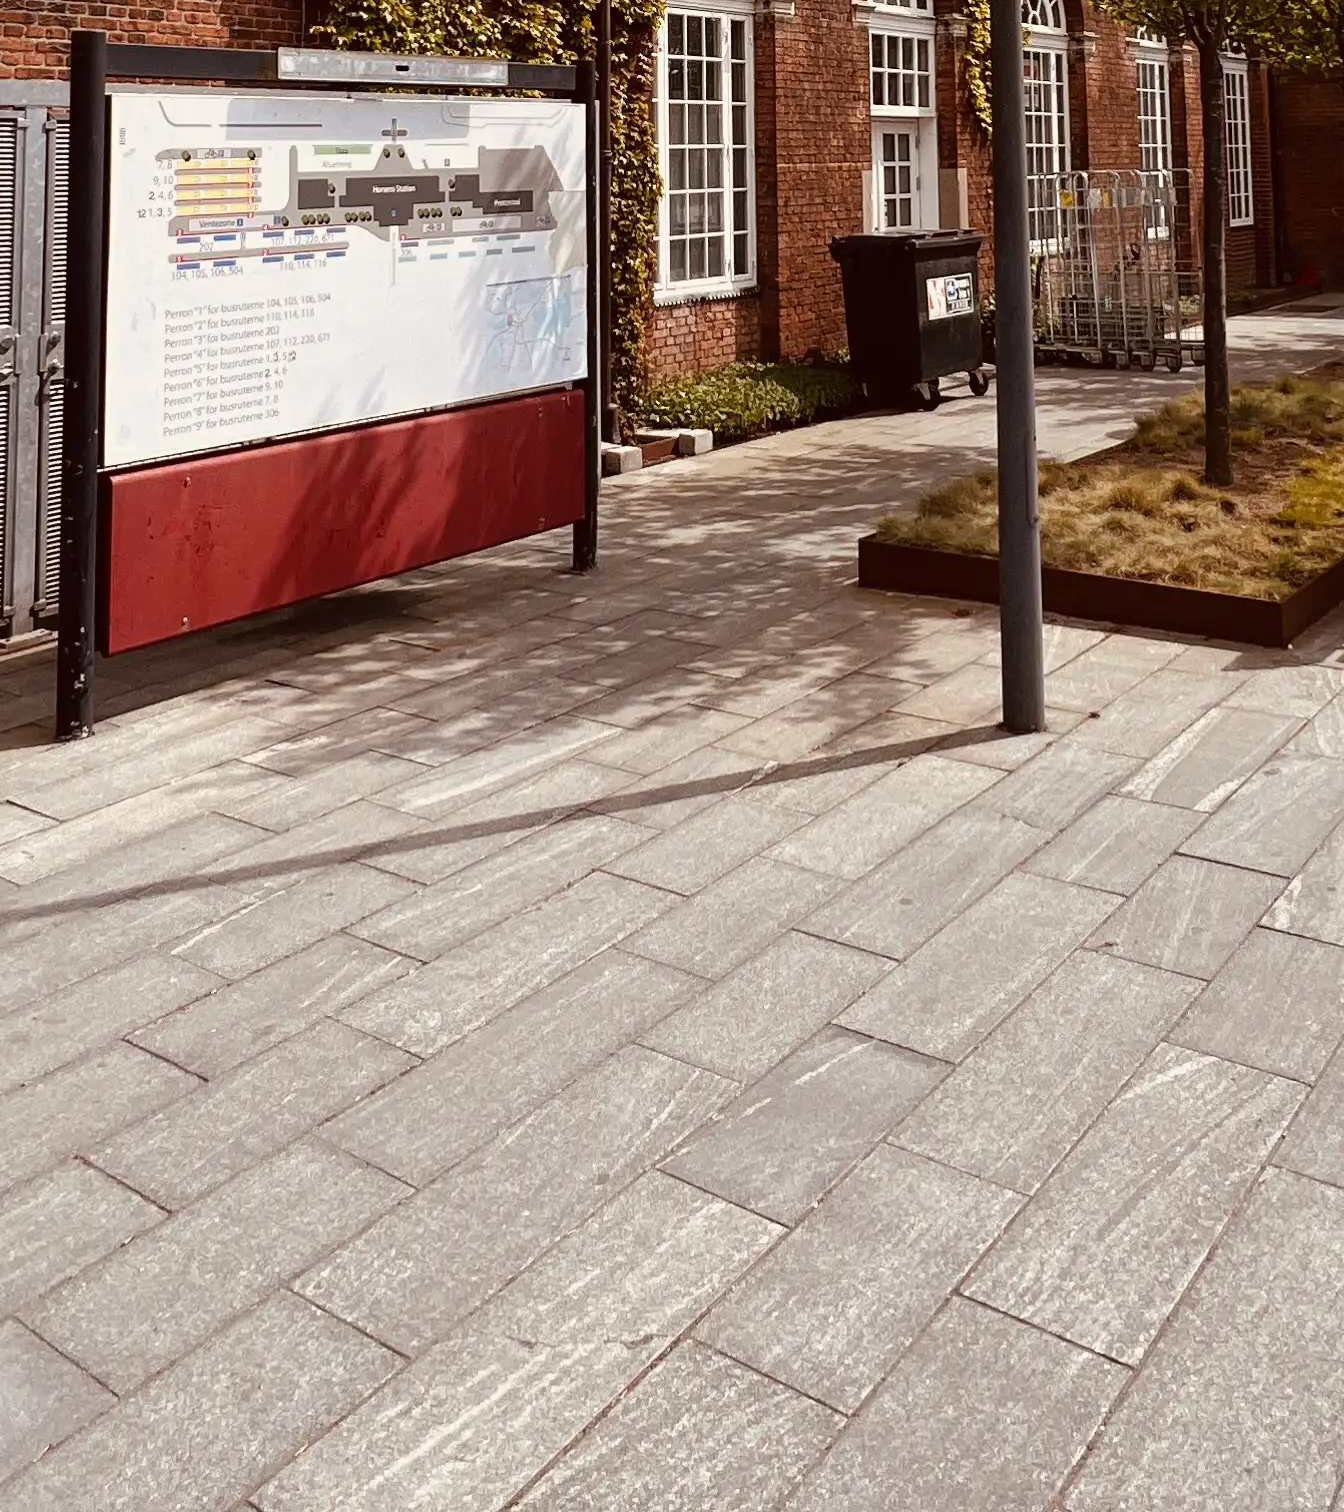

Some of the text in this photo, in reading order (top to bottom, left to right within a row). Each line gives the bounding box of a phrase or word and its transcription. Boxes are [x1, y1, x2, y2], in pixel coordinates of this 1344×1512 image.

[165, 308, 193, 319] Perron
[207, 304, 219, 314] for
[221, 301, 264, 314] busruterne
[165, 322, 193, 334] Perron
[207, 318, 219, 329] for
[221, 315, 264, 327] busruterne
[164, 337, 193, 348] Perron
[207, 332, 219, 344] for
[221, 329, 264, 342] busruterne
[164, 351, 192, 363] Perron
[207, 346, 218, 358] for
[221, 343, 264, 356] busruterne
[164, 366, 192, 378] Perron
[207, 360, 218, 371] for
[220, 356, 264, 370] busruterne
[164, 380, 192, 392] Perron
[207, 374, 218, 386] for
[220, 371, 263, 384] busruterne
[164, 395, 192, 406] Perron
[206, 388, 218, 400] for
[220, 385, 263, 398] busruterne
[164, 410, 192, 421] Perron
[206, 403, 218, 414] for
[220, 399, 263, 413] busruterne
[163, 424, 192, 436] Perron
[206, 417, 217, 428] for
[219, 413, 263, 427] busruterne
